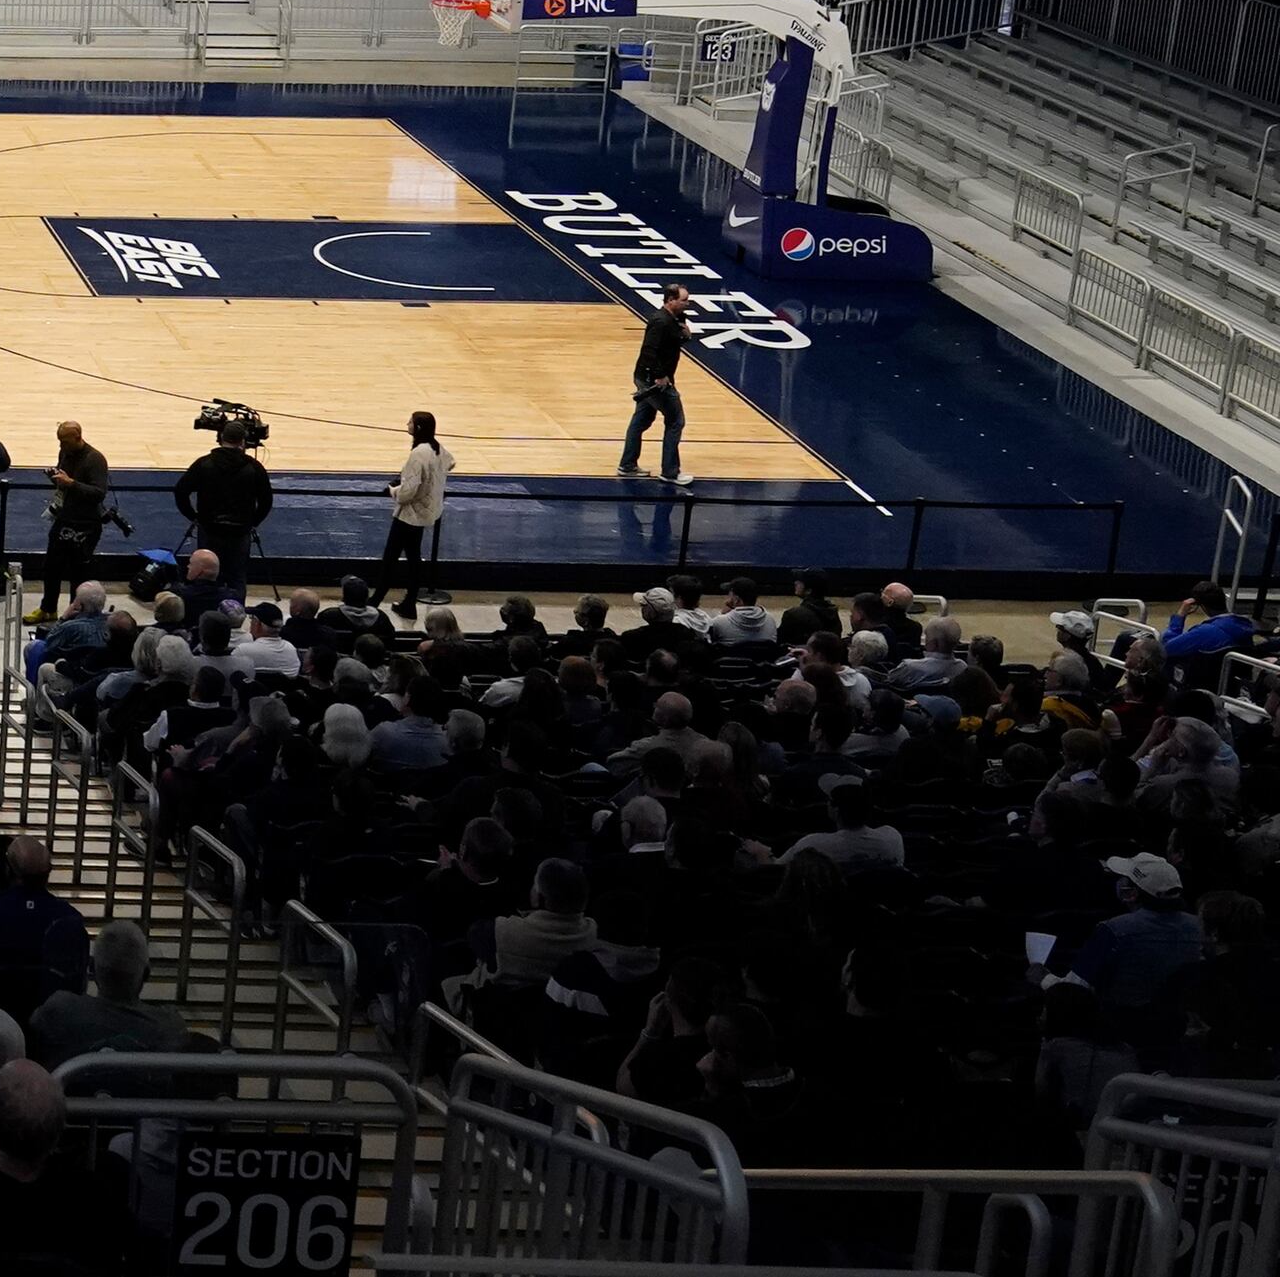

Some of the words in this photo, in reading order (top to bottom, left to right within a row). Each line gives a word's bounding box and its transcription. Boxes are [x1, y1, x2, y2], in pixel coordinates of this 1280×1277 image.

[706, 43, 737, 60] 123
[789, 19, 827, 52] SPALDING
[104, 231, 184, 289] EAST
[148, 237, 221, 280] BIG
[818, 235, 887, 257] pepsi
[504, 191, 812, 350] BUTLER
[186, 1147, 353, 1180] SECTION
[178, 1190, 349, 1271] 206
